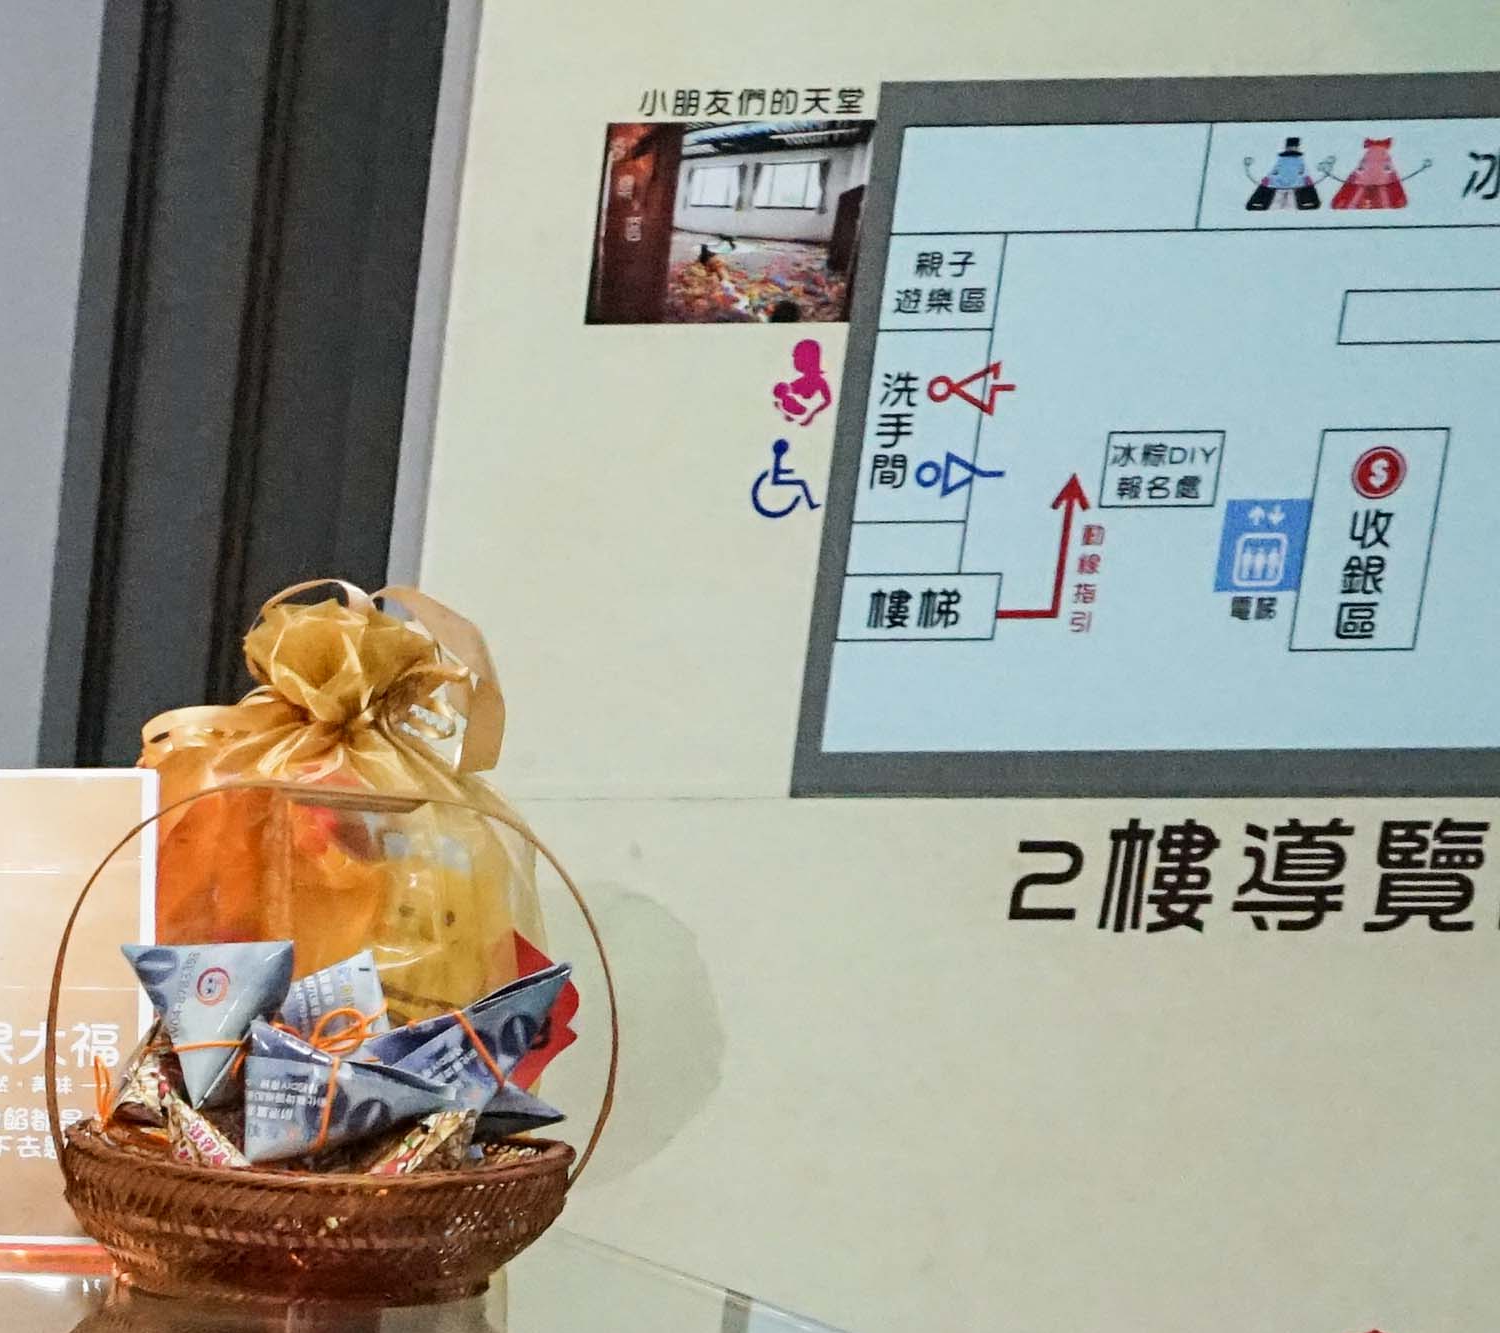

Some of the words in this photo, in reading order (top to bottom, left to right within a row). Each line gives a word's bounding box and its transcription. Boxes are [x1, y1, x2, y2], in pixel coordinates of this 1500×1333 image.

[639, 88, 865, 117] 小朋友們的天堂
[915, 251, 976, 278] 親子
[893, 288, 986, 314] 遊樂區
[869, 371, 920, 491] 洗手間
[1110, 443, 1217, 468] 冰粽DIY
[1116, 475, 1203, 501] 報名處
[1334, 509, 1394, 640] 收銀區
[865, 584, 963, 633] 樓梯
[1008, 817, 1500, 934] 2樓導覽
